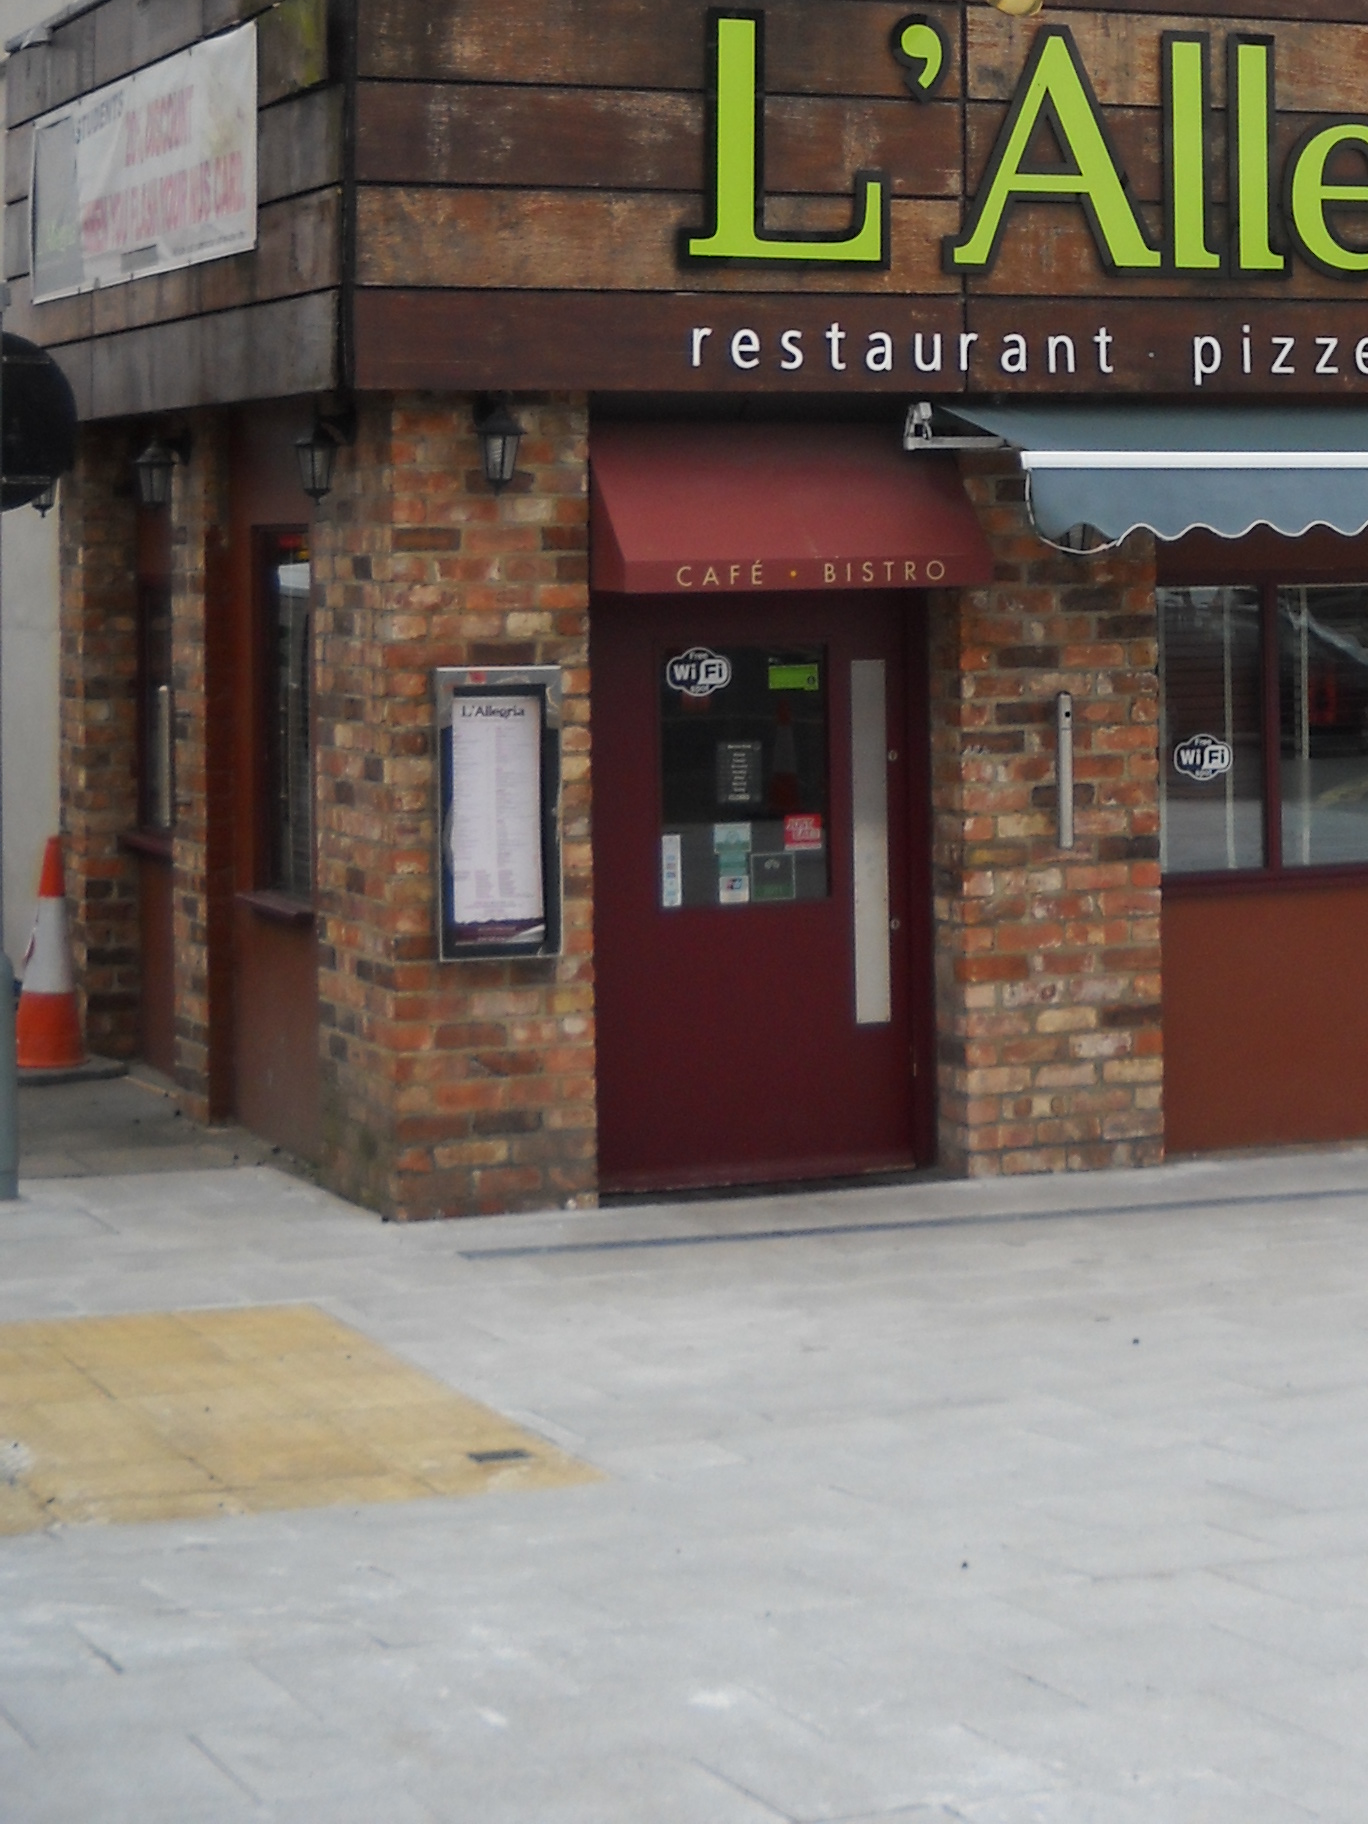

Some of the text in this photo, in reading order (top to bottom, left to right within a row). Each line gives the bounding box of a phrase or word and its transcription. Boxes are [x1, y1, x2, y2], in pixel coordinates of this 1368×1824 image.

[75, 89, 124, 144] STUDENTS
[691, 321, 1114, 374] restaurant
[676, 558, 946, 587] CAFÉ BISTRO
[461, 705, 525, 719] L'Allegria
